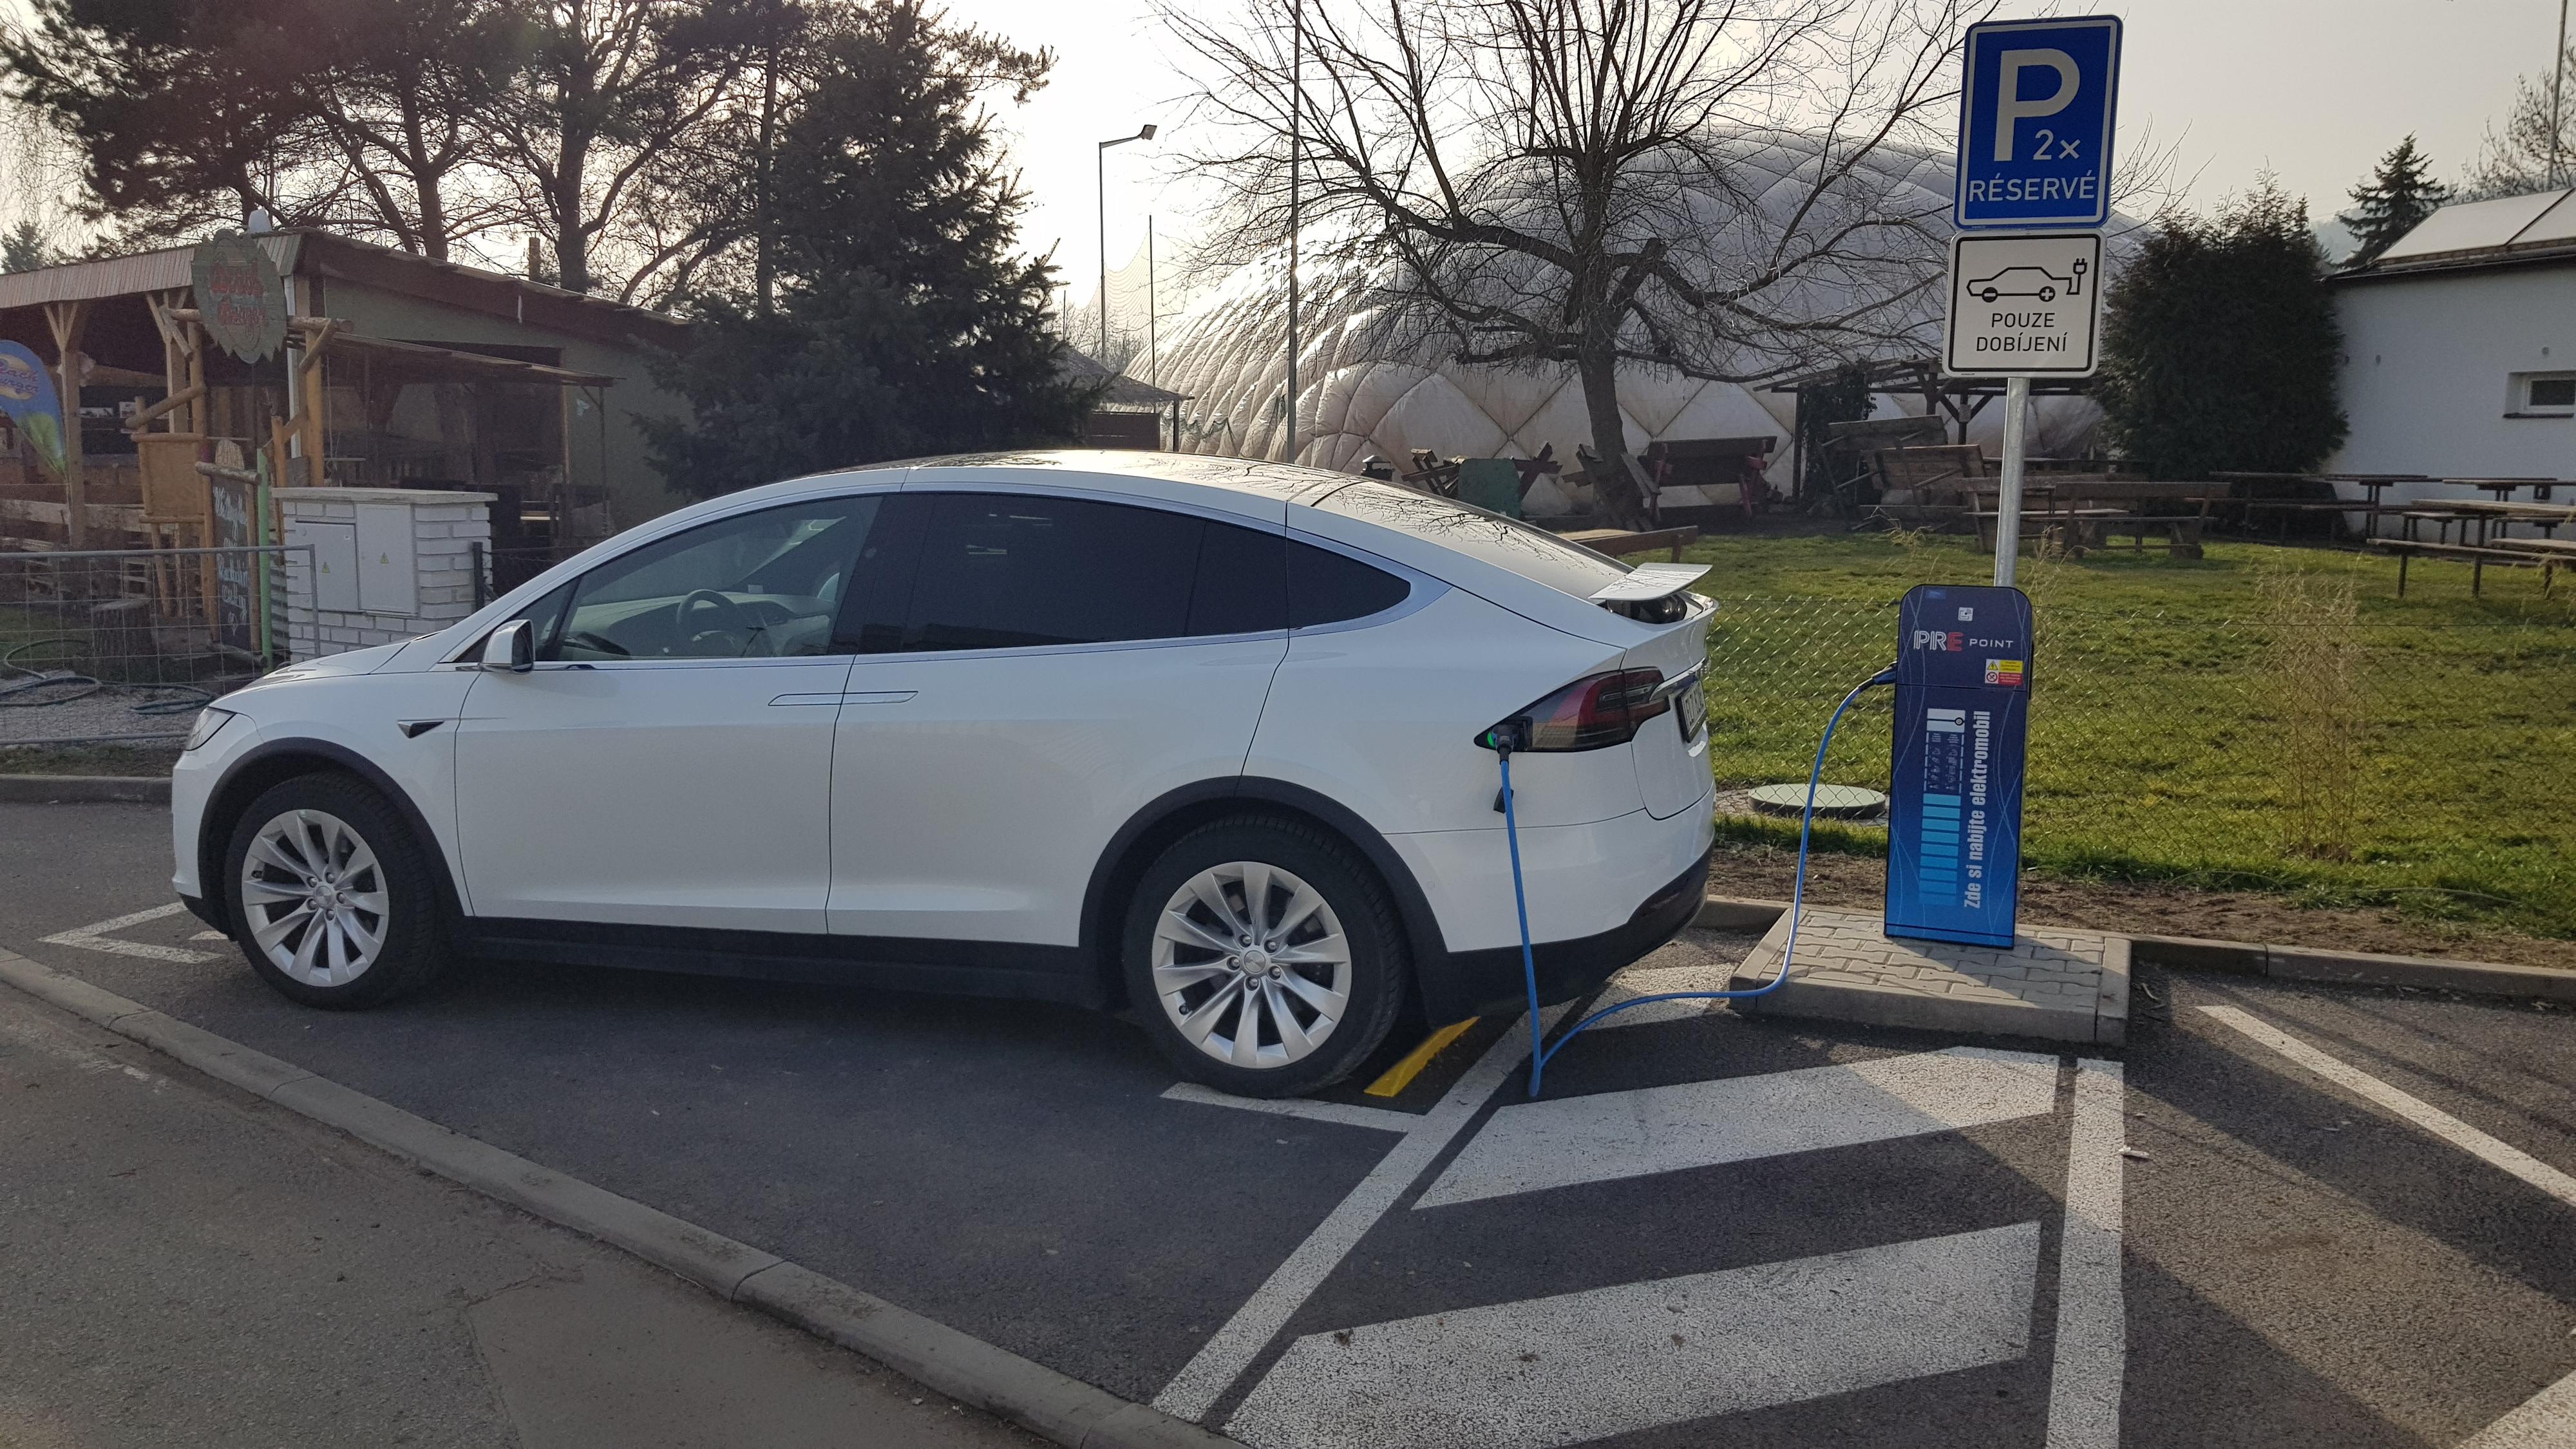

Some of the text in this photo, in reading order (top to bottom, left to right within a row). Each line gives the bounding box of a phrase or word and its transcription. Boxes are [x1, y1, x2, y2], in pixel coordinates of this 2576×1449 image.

[1994, 48, 2080, 162] P
[1968, 169, 2097, 202] RÉSERVÉ
[1990, 312, 2056, 328] POUZE
[1975, 331, 2067, 352] DOBÍJENÍ
[1913, 630, 2014, 652] PRE POINT
[1964, 710, 1991, 909] Zde si nabijte elektromobil
